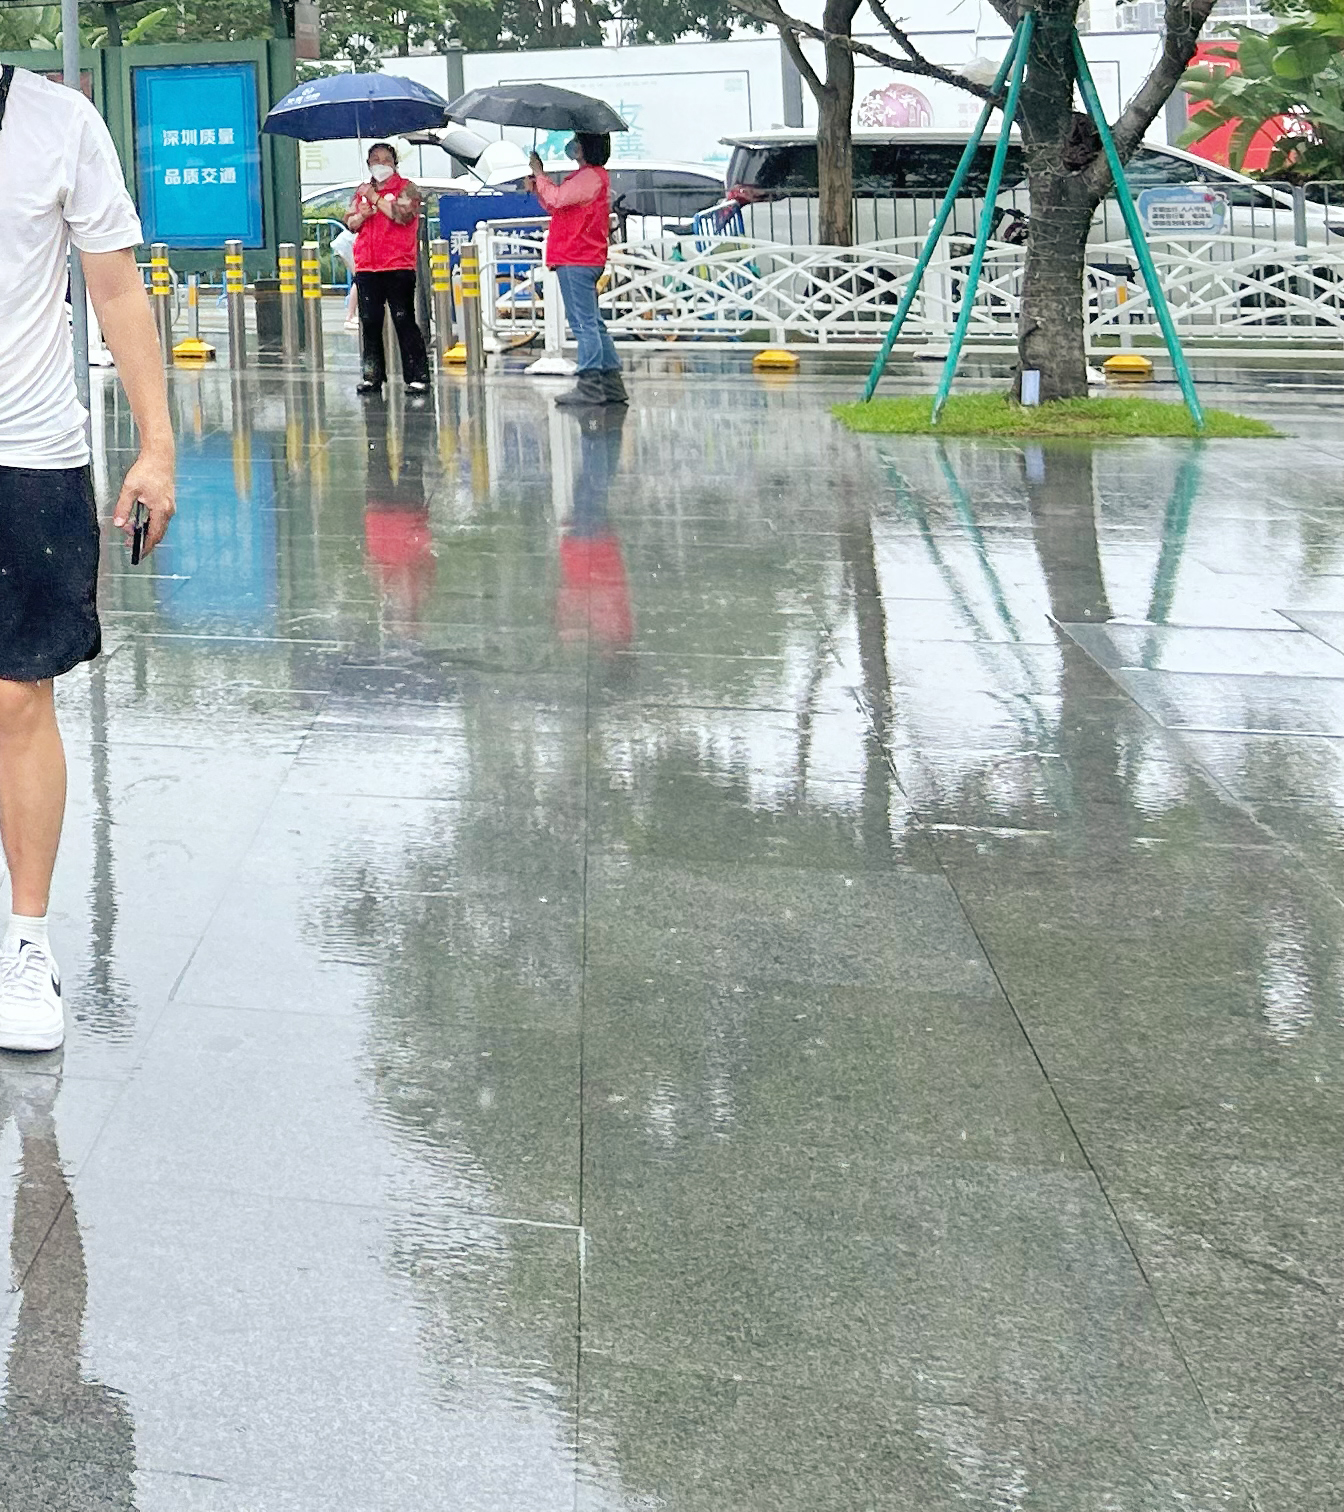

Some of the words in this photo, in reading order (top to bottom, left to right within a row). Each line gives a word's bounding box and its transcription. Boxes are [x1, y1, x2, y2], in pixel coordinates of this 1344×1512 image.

[162, 127, 235, 146] 深圳质量
[164, 166, 237, 185] 品质交通
